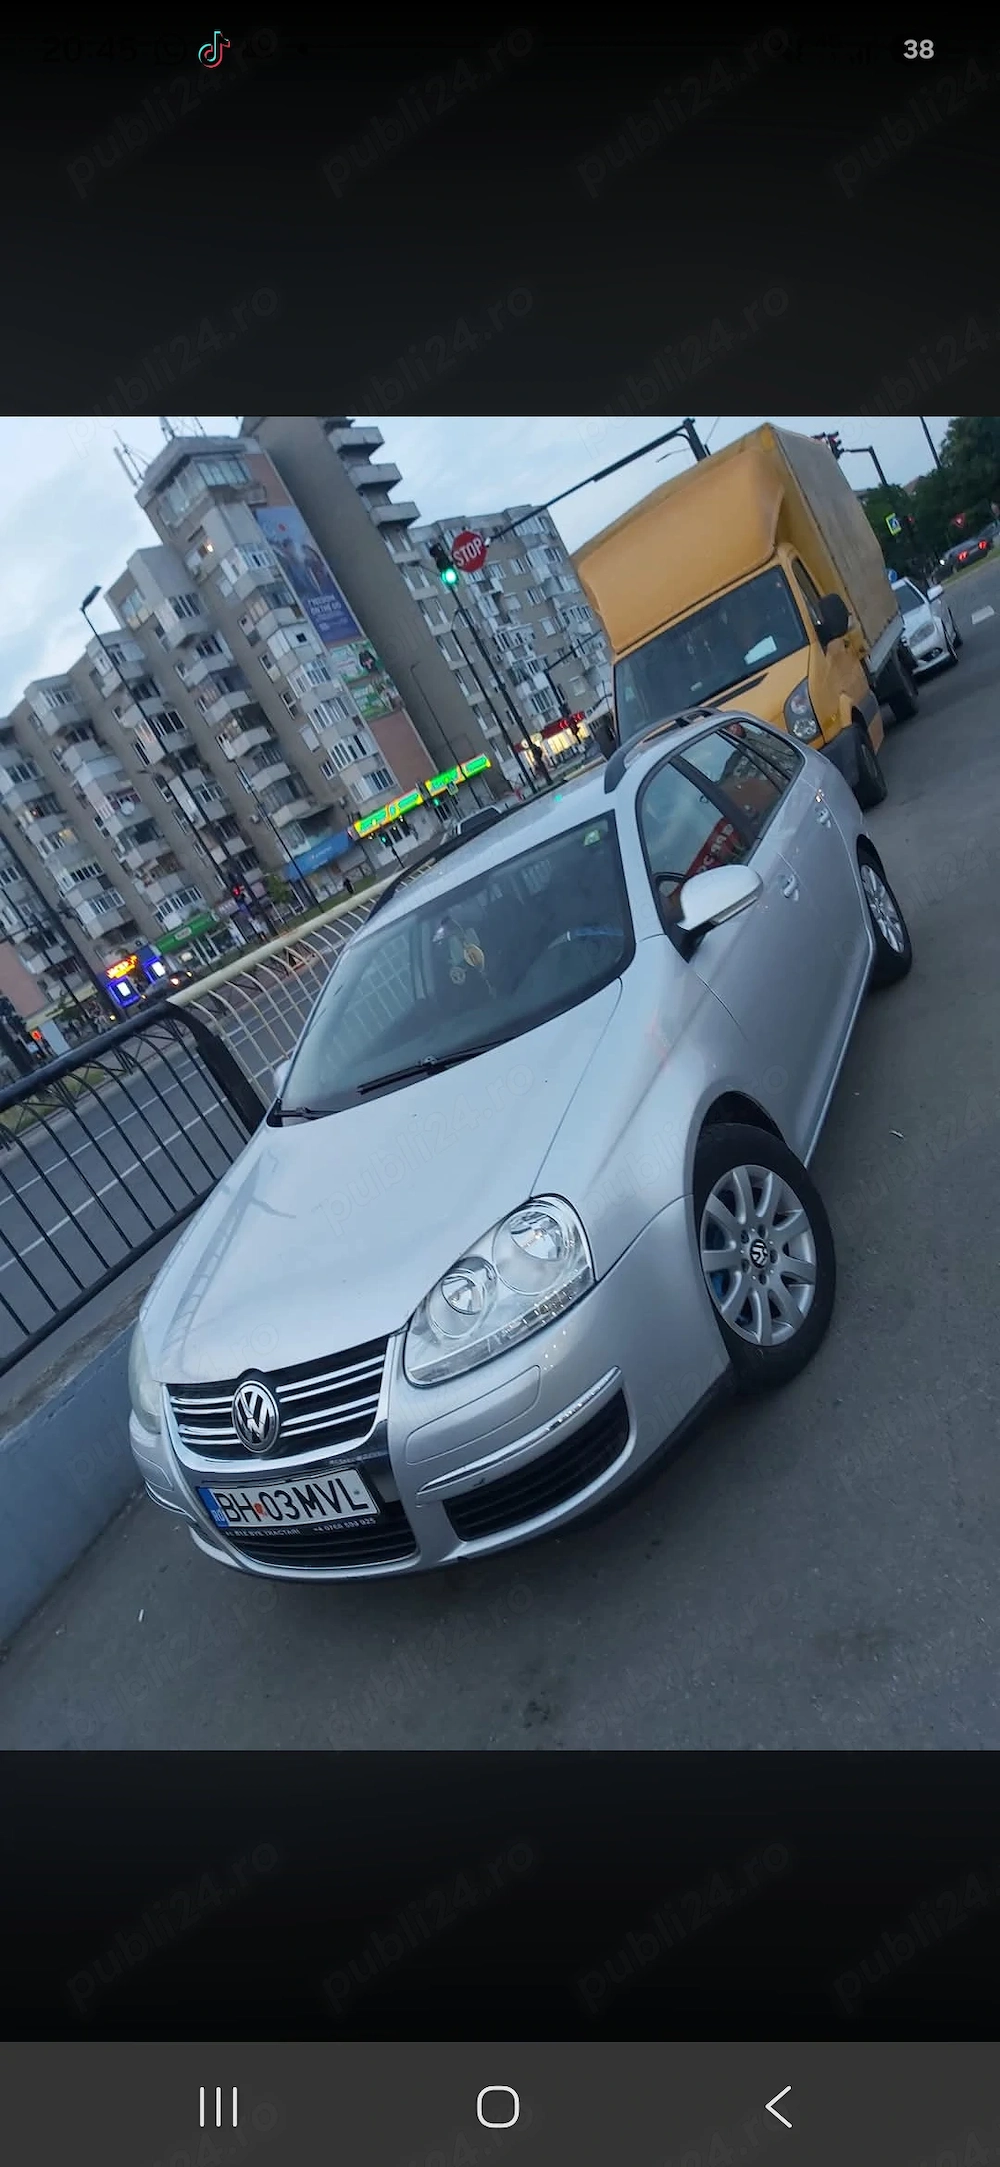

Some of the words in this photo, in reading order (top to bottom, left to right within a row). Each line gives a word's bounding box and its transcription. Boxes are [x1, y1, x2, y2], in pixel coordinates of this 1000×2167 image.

[453, 537, 483, 567] STOP
[215, 1491, 262, 1524] BH
[261, 1488, 299, 1522] 03
[297, 1477, 370, 1519] MVL
